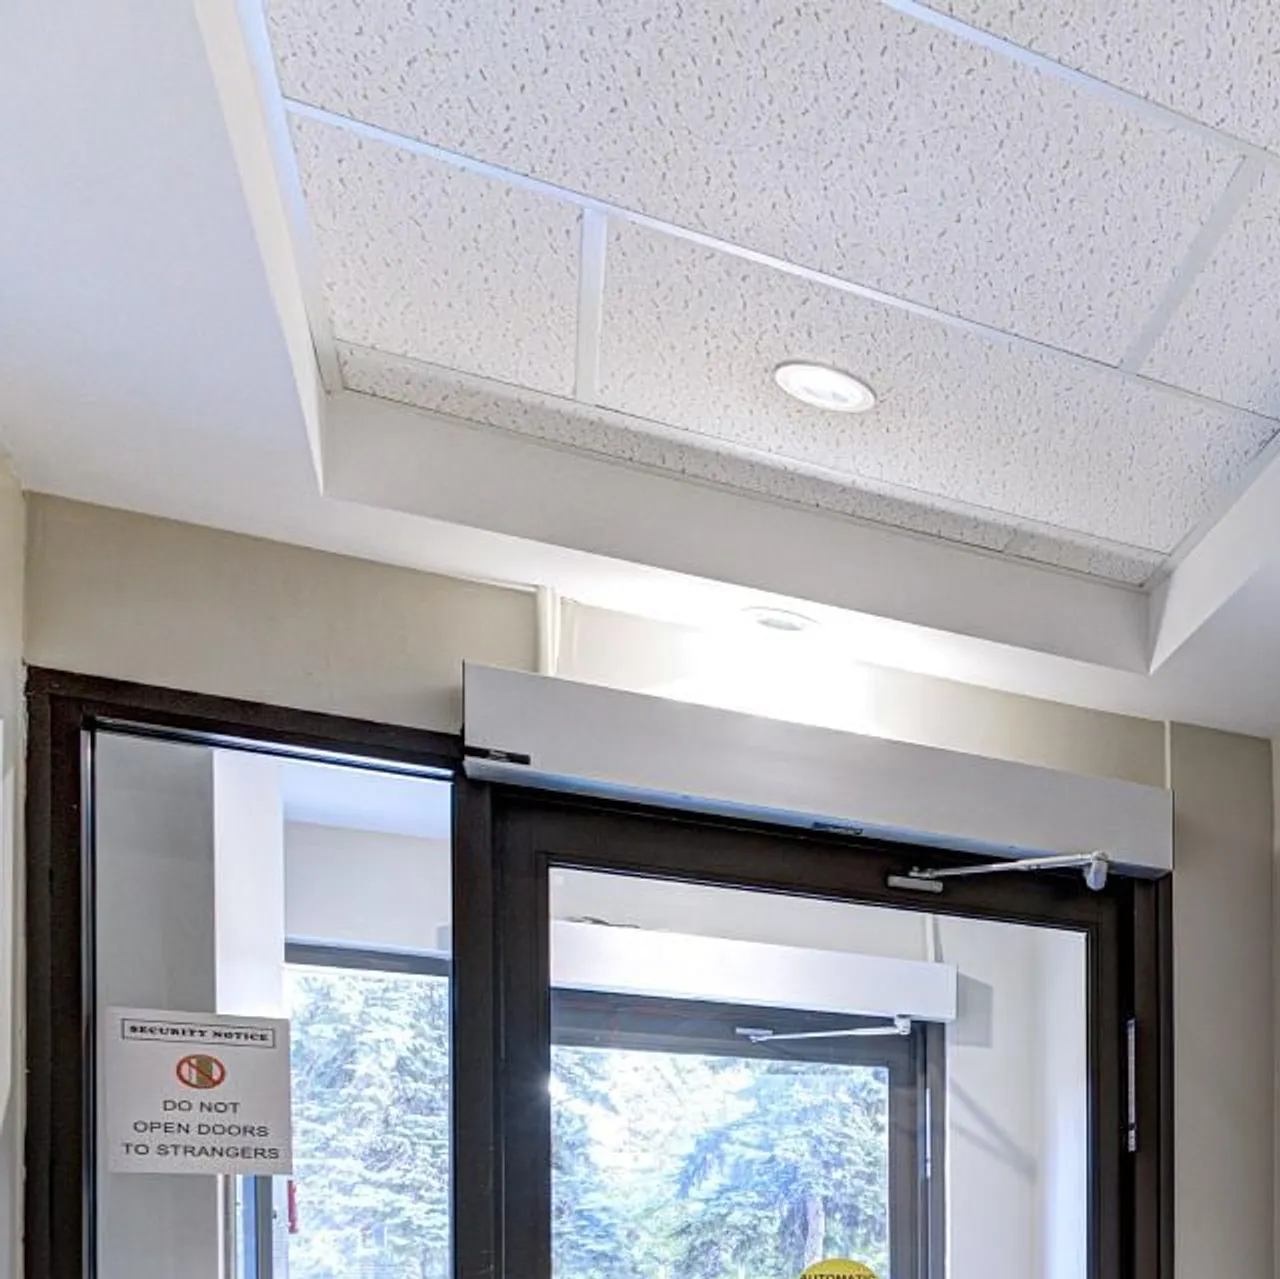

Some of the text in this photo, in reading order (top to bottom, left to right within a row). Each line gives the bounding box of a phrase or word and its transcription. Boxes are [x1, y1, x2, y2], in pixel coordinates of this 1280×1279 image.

[129, 1025, 269, 1041] SECURITY NOTICE
[162, 1100, 240, 1113] DO NOT
[133, 1121, 269, 1137] OPEN DOORS
[122, 1143, 280, 1159] TO STRANGERS
